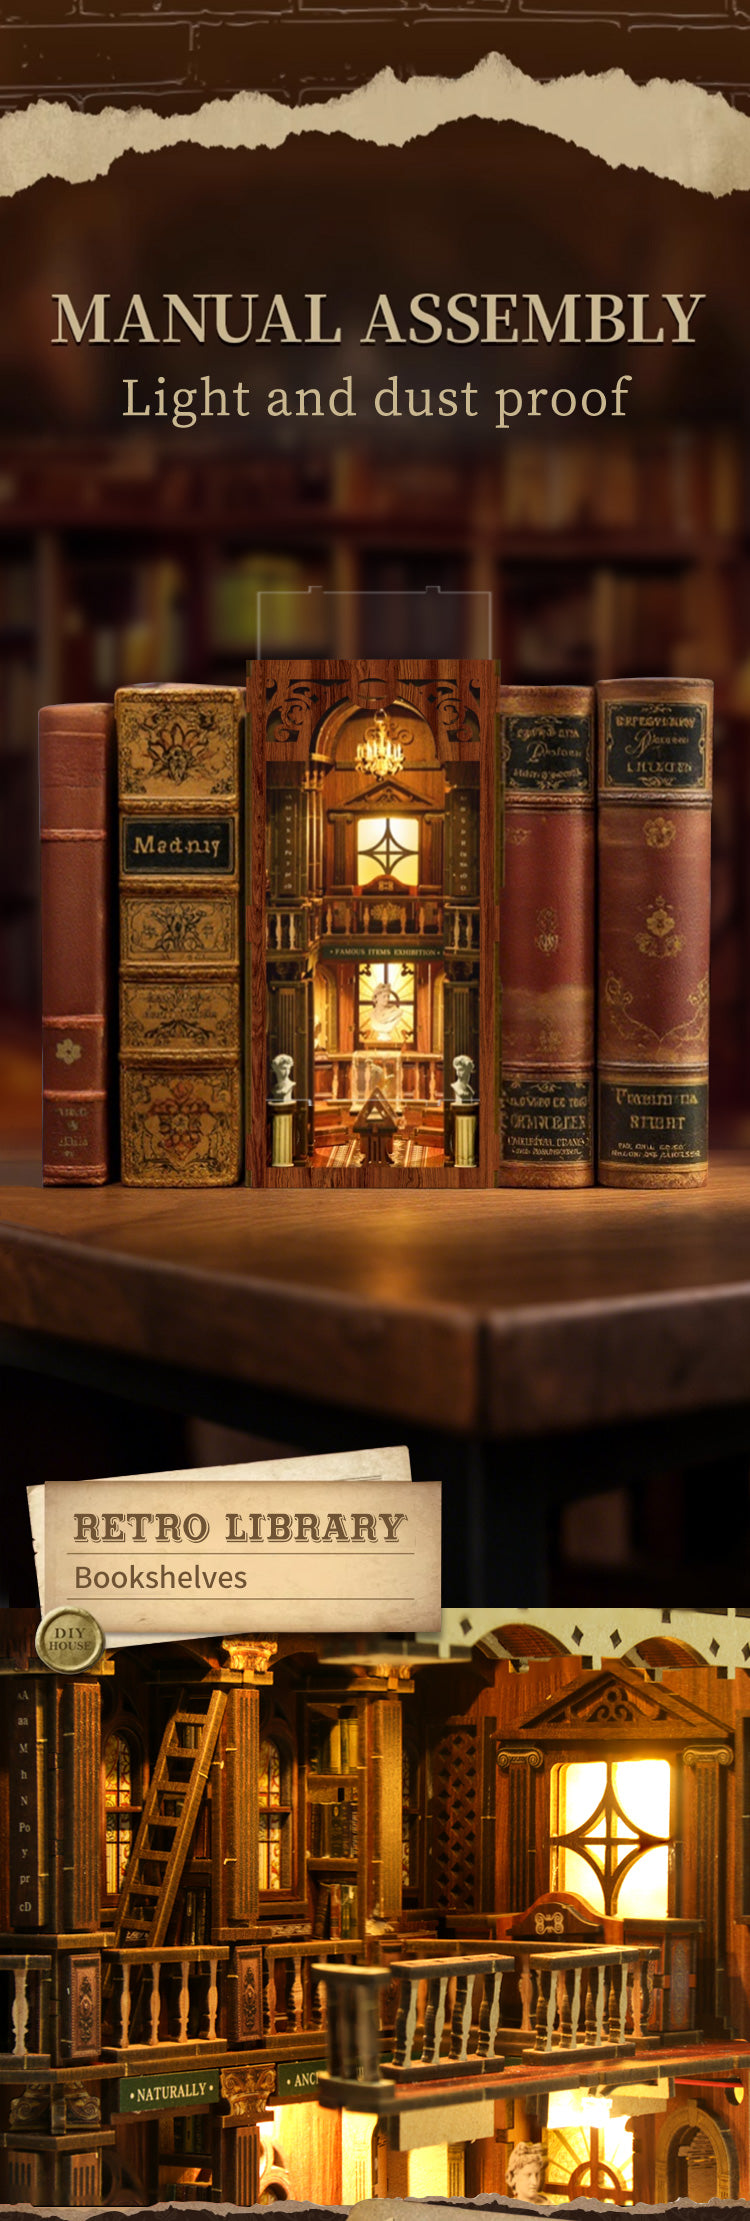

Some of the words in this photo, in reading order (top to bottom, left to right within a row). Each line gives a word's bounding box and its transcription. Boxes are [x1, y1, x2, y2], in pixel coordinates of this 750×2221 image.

[335, 948, 365, 956] FAMOUS
[368, 948, 391, 956] ITEMS
[394, 948, 436, 956] EXHIBITION
[294, 2071, 319, 2087] ANCI
[137, 2082, 207, 2102] NATURALLY
